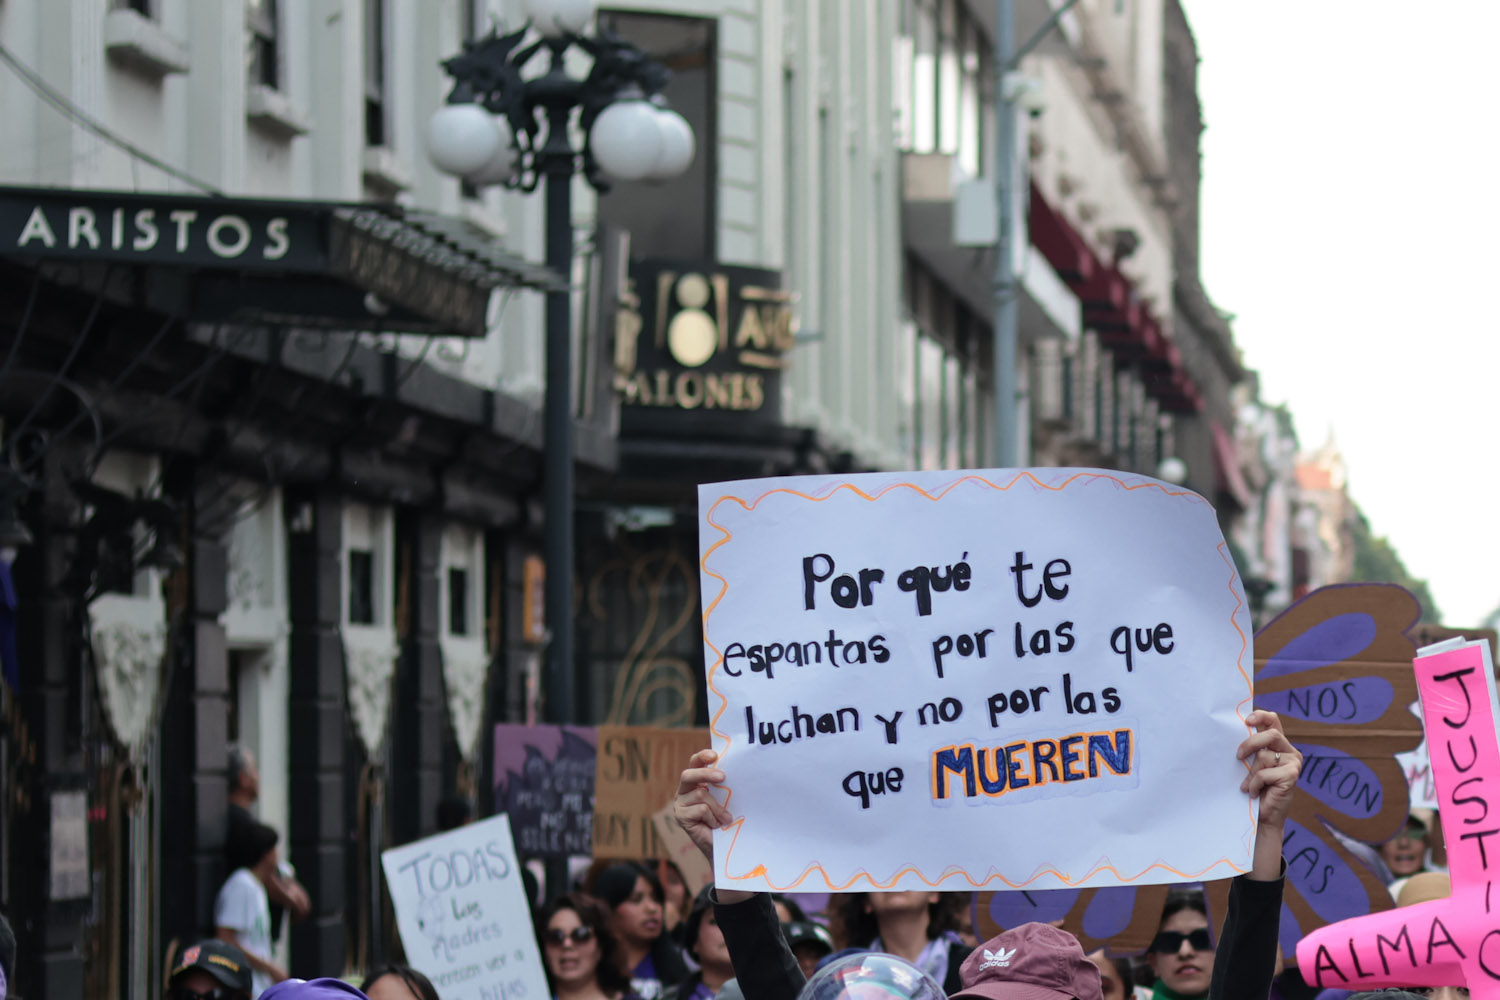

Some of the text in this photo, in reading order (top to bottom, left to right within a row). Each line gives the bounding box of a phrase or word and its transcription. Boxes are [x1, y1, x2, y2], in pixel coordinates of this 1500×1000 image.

[17, 205, 290, 261] ARISTOS
[802, 551, 1072, 616] Por qué te
[722, 620, 1175, 679] espantas por las que
[745, 704, 860, 746] luchan
[917, 696, 963, 726] no
[987, 683, 1050, 728] por
[1063, 673, 1122, 715] las
[1287, 681, 1358, 720] NOS
[604, 736, 649, 784] SIN
[842, 728, 1135, 810] que MUEREN
[398, 842, 511, 893] TODAS
[978, 960, 1010, 972] adidas
[1314, 917, 1467, 989] ALMA
